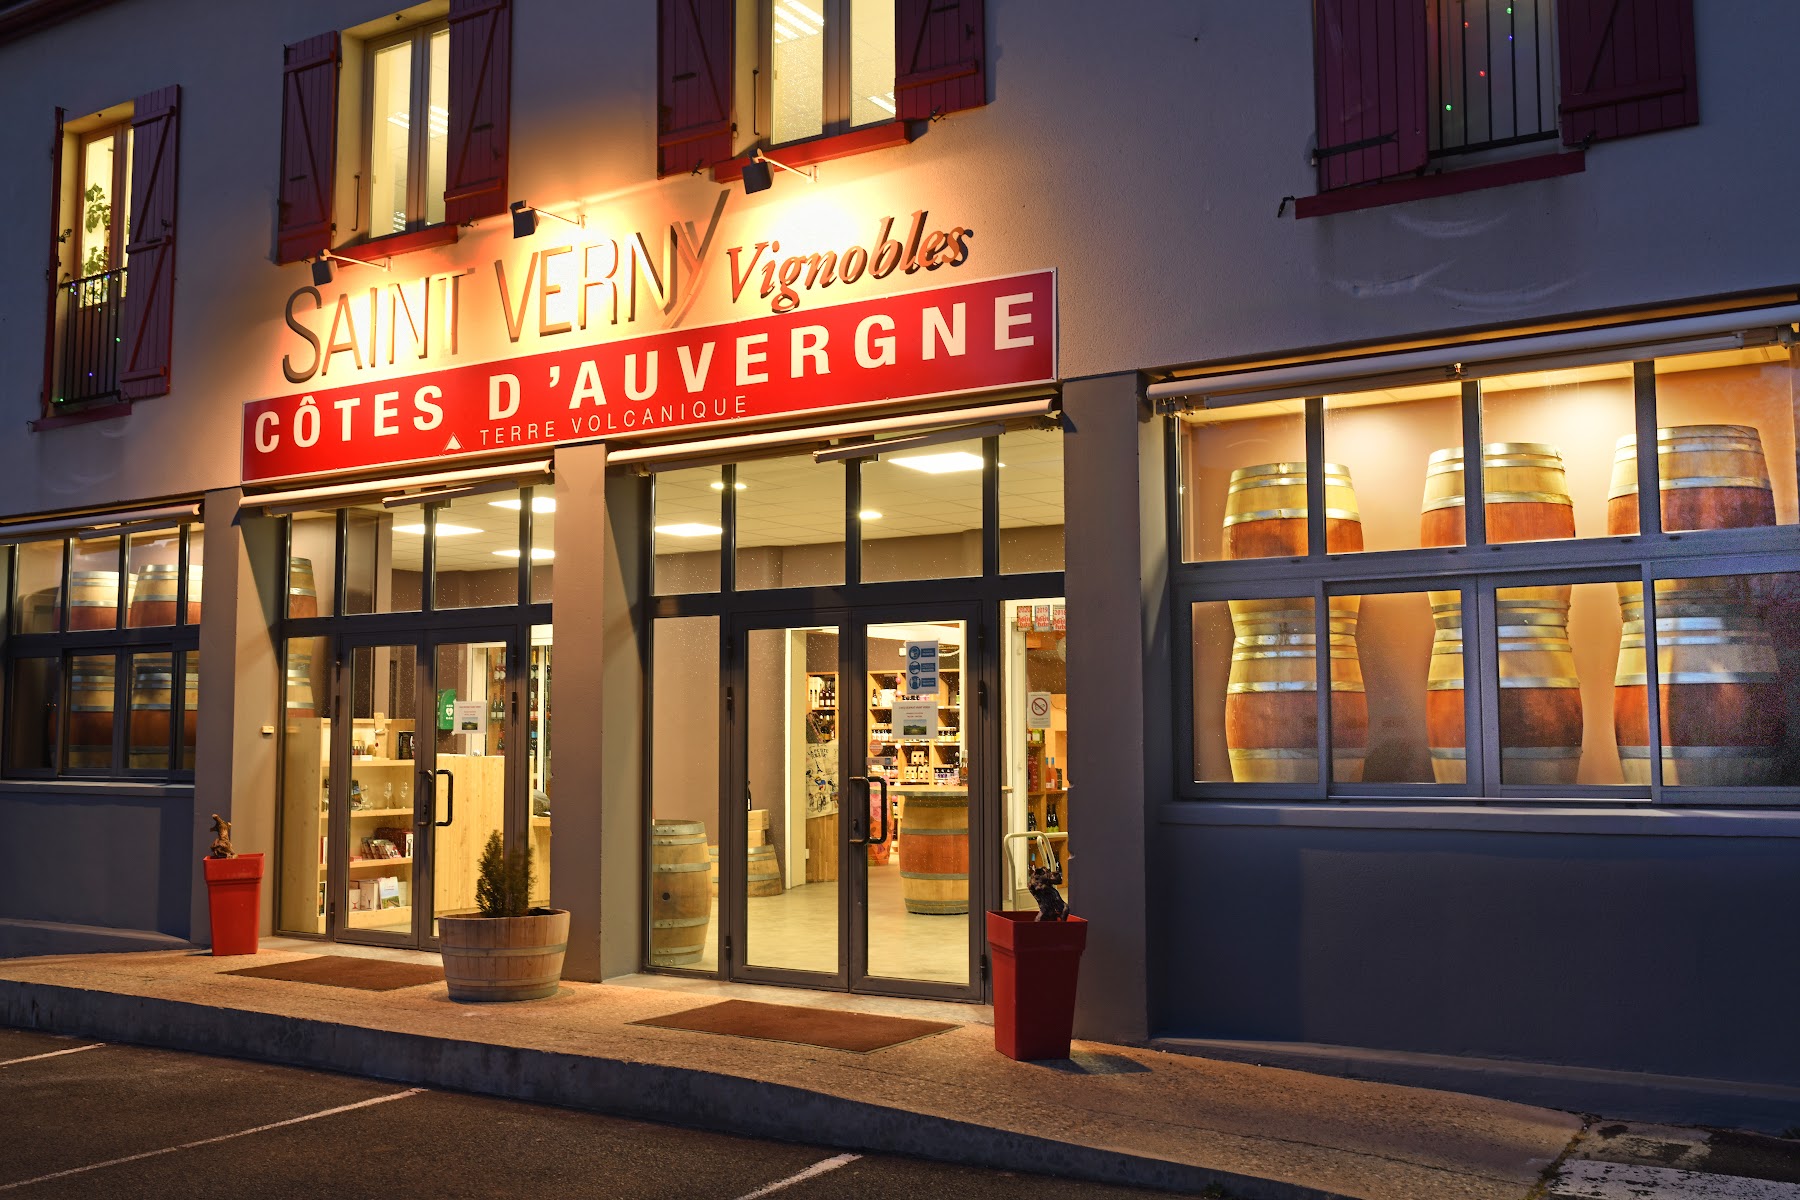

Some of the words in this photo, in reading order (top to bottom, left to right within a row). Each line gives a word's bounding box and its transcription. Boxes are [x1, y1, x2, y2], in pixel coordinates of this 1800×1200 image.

[282, 266, 475, 383] SAINT
[494, 189, 731, 343] VERNY
[726, 209, 974, 313] Vignobles
[254, 384, 444, 454] CÔTES
[479, 420, 555, 446] TERRE
[571, 395, 747, 434] VOLCANIQUE
